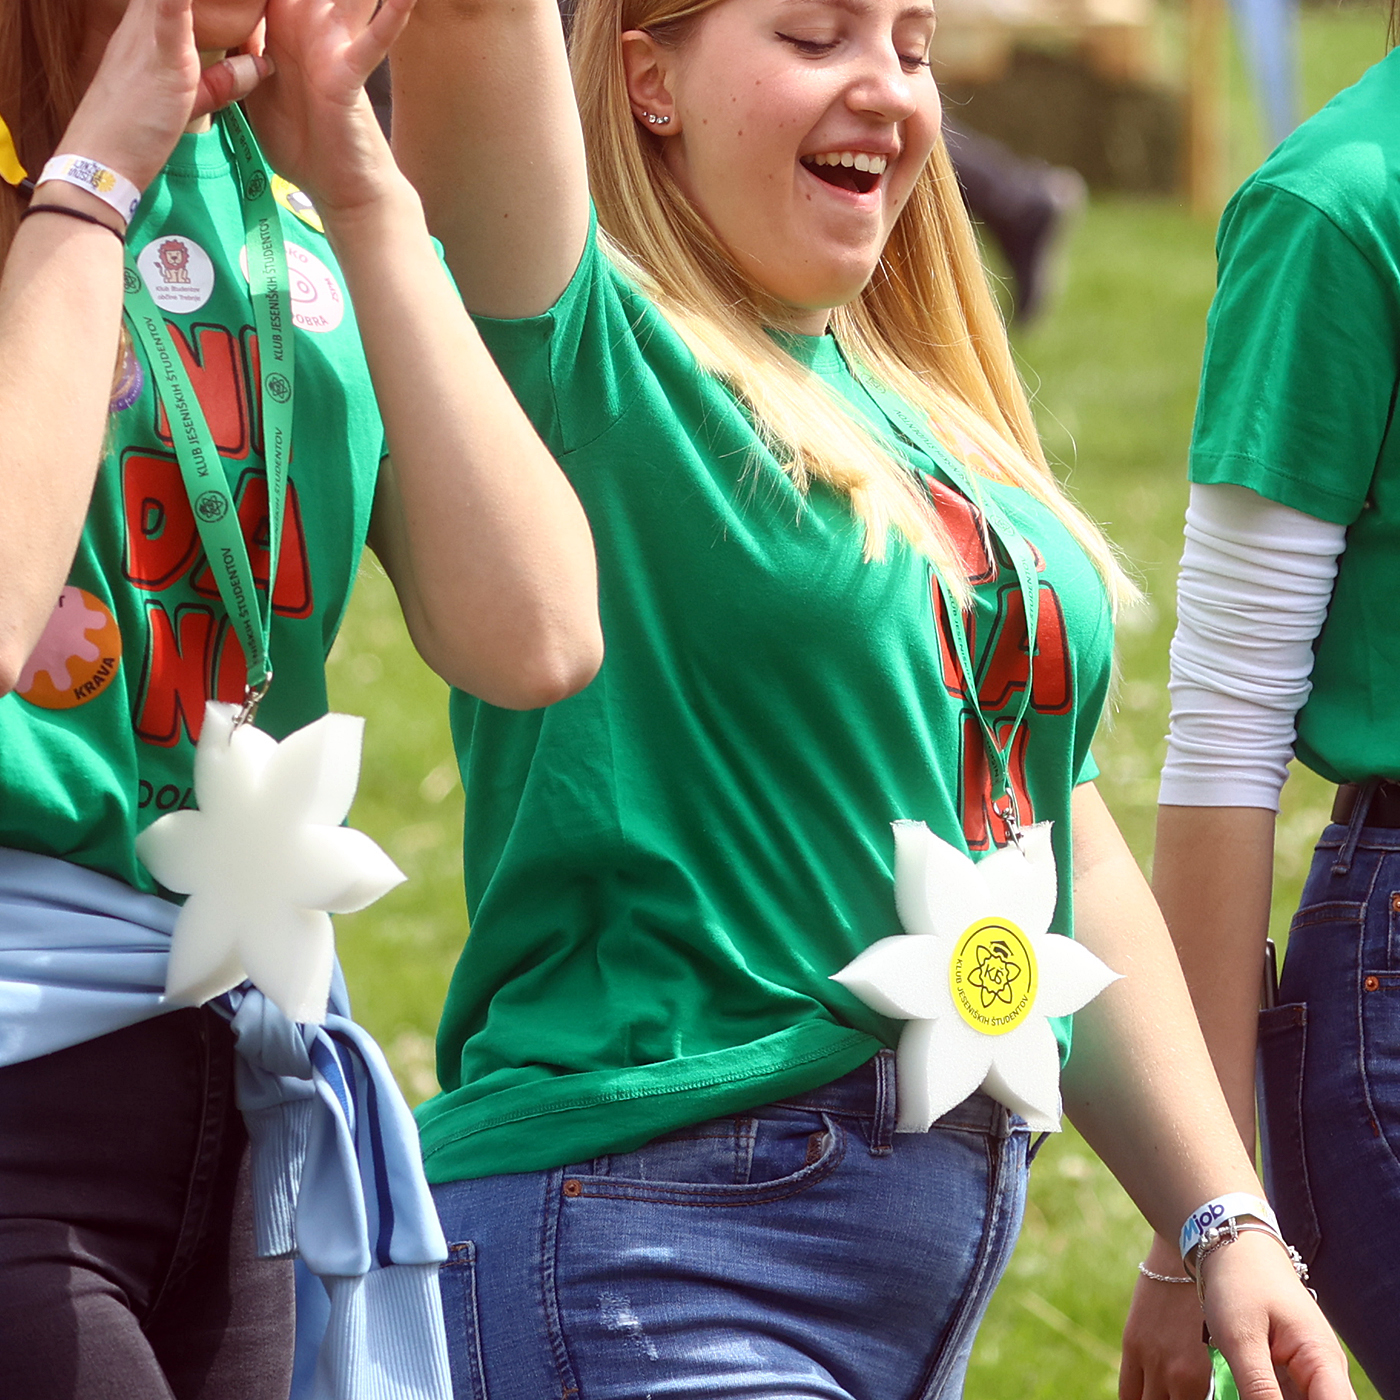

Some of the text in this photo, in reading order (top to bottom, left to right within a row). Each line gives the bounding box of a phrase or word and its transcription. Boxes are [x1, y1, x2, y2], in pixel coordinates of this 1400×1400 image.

[265, 276, 282, 332] JESENIŠKIH
[295, 313, 329, 327] OBRA
[270, 334, 284, 361] KLUB
[143, 315, 210, 478] KLUB JESENIŠKIH ŠTUDENTOV
[221, 547, 250, 619] ŠTUDENTOV
[73, 656, 115, 701] KRAVA
[955, 957, 1030, 1027] KLUB JESENIŠKIH ŠTUDENTOV
